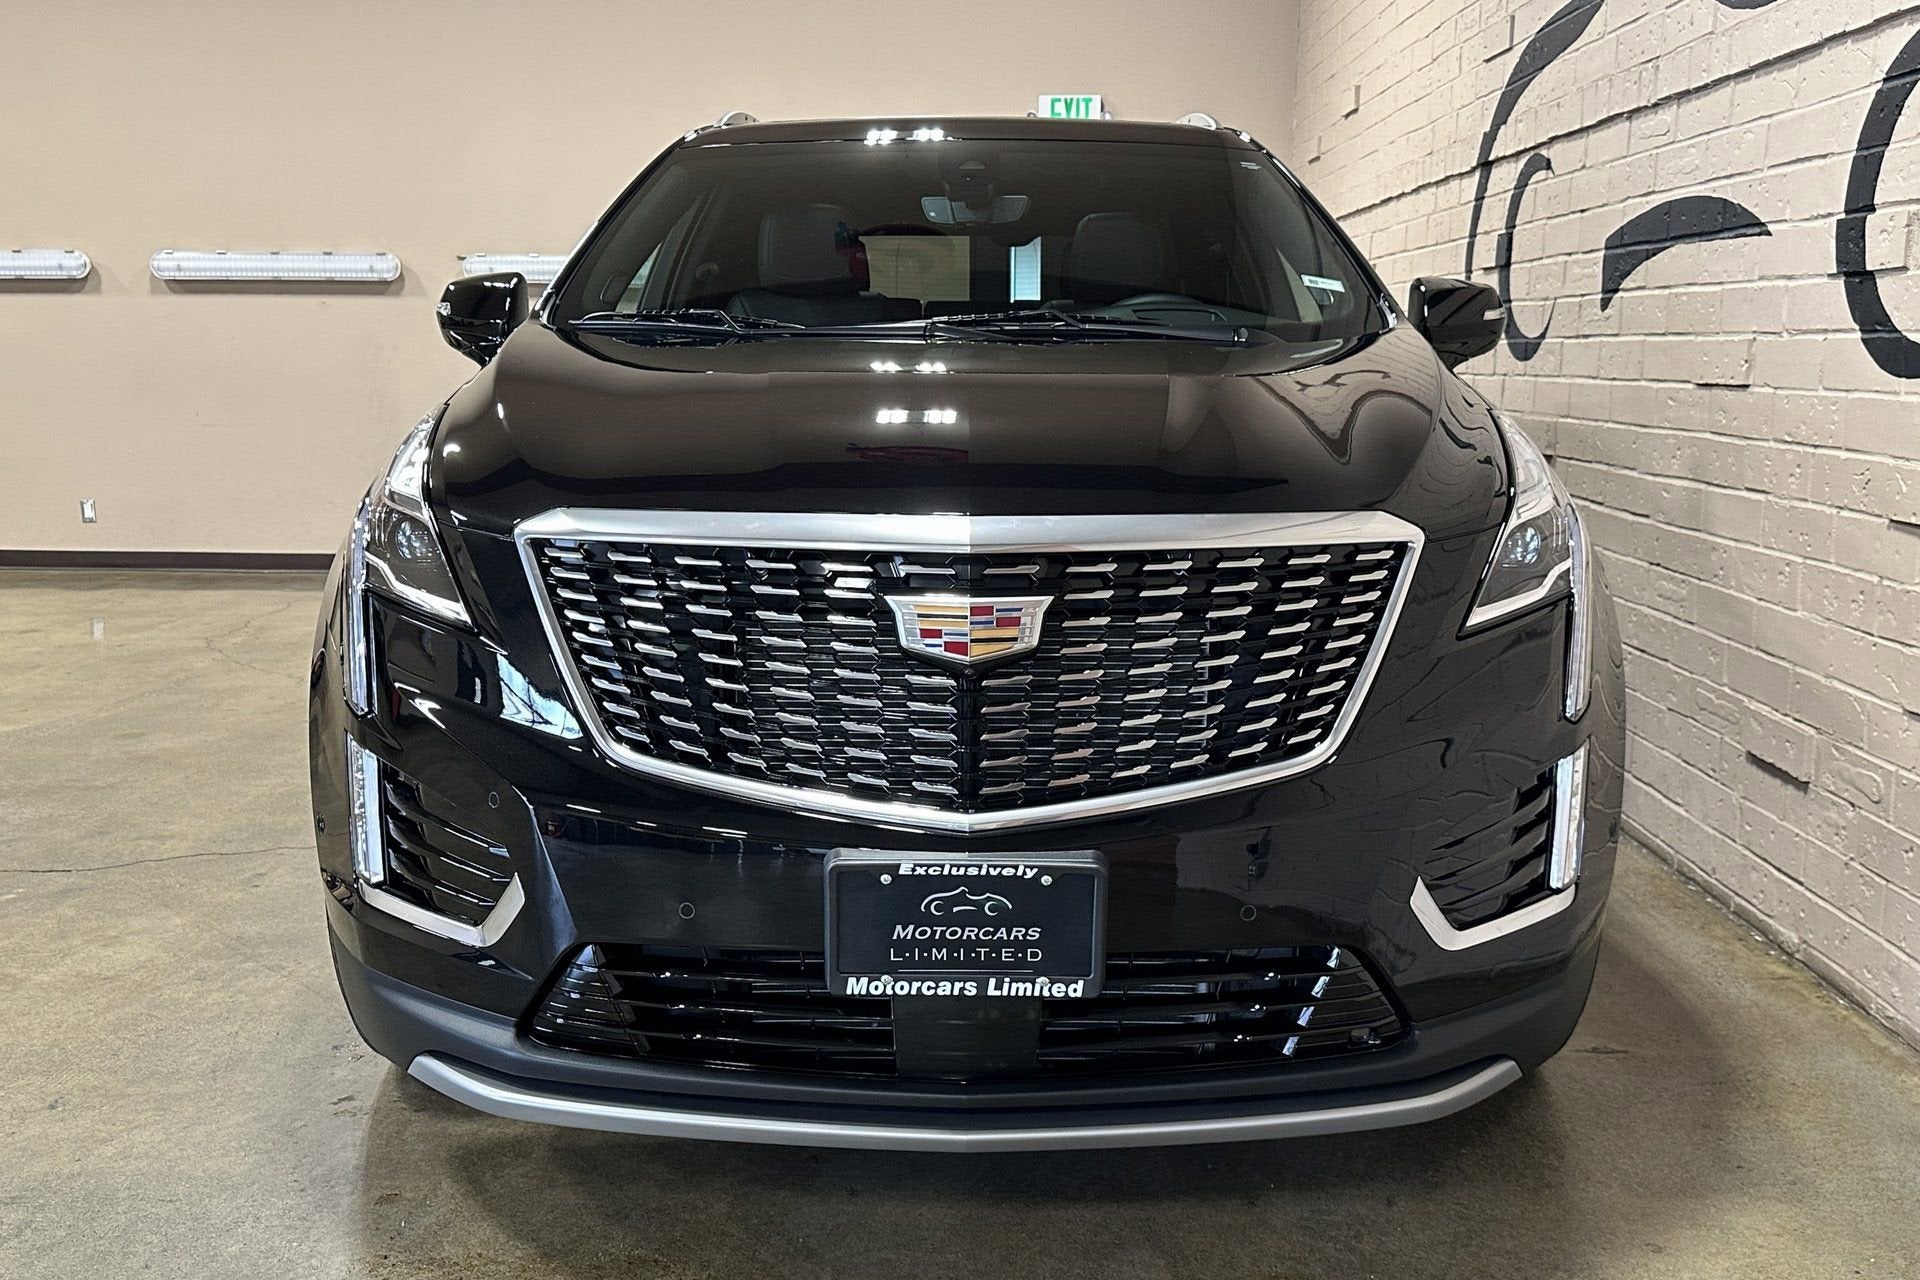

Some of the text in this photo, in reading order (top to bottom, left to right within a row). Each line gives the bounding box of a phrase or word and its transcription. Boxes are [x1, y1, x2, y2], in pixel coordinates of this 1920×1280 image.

[1050, 97, 1093, 118] EXIT
[898, 862, 1039, 879] Exclusively
[892, 924, 1042, 940] MOTORCARS
[845, 976, 978, 996] Motorcars
